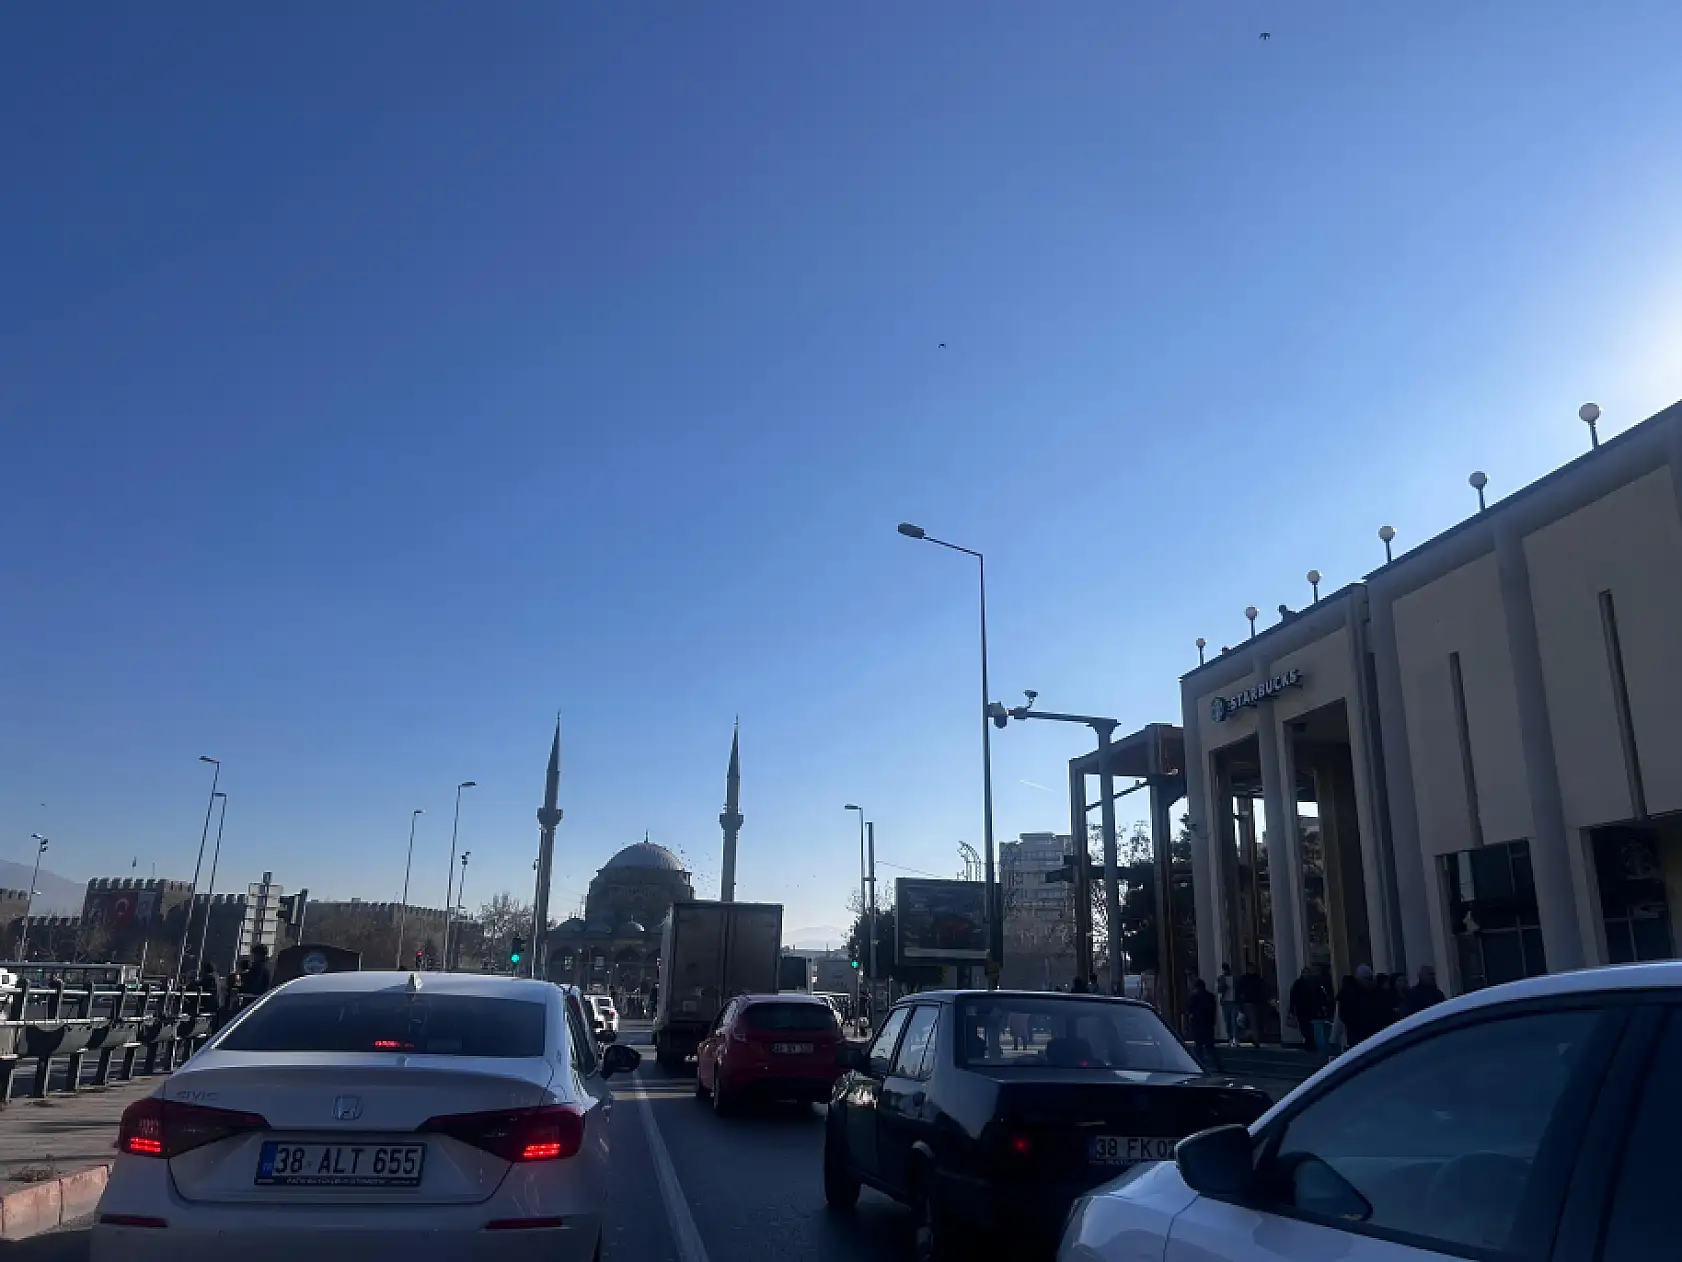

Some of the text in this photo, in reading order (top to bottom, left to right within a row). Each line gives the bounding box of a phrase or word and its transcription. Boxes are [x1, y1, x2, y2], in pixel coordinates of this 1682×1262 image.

[1229, 669, 1300, 712] STARBUCKS
[276, 1147, 419, 1175] 38 ALT 655
[1096, 1137, 1118, 1158] 38
[1128, 1137, 1153, 1158] FK
